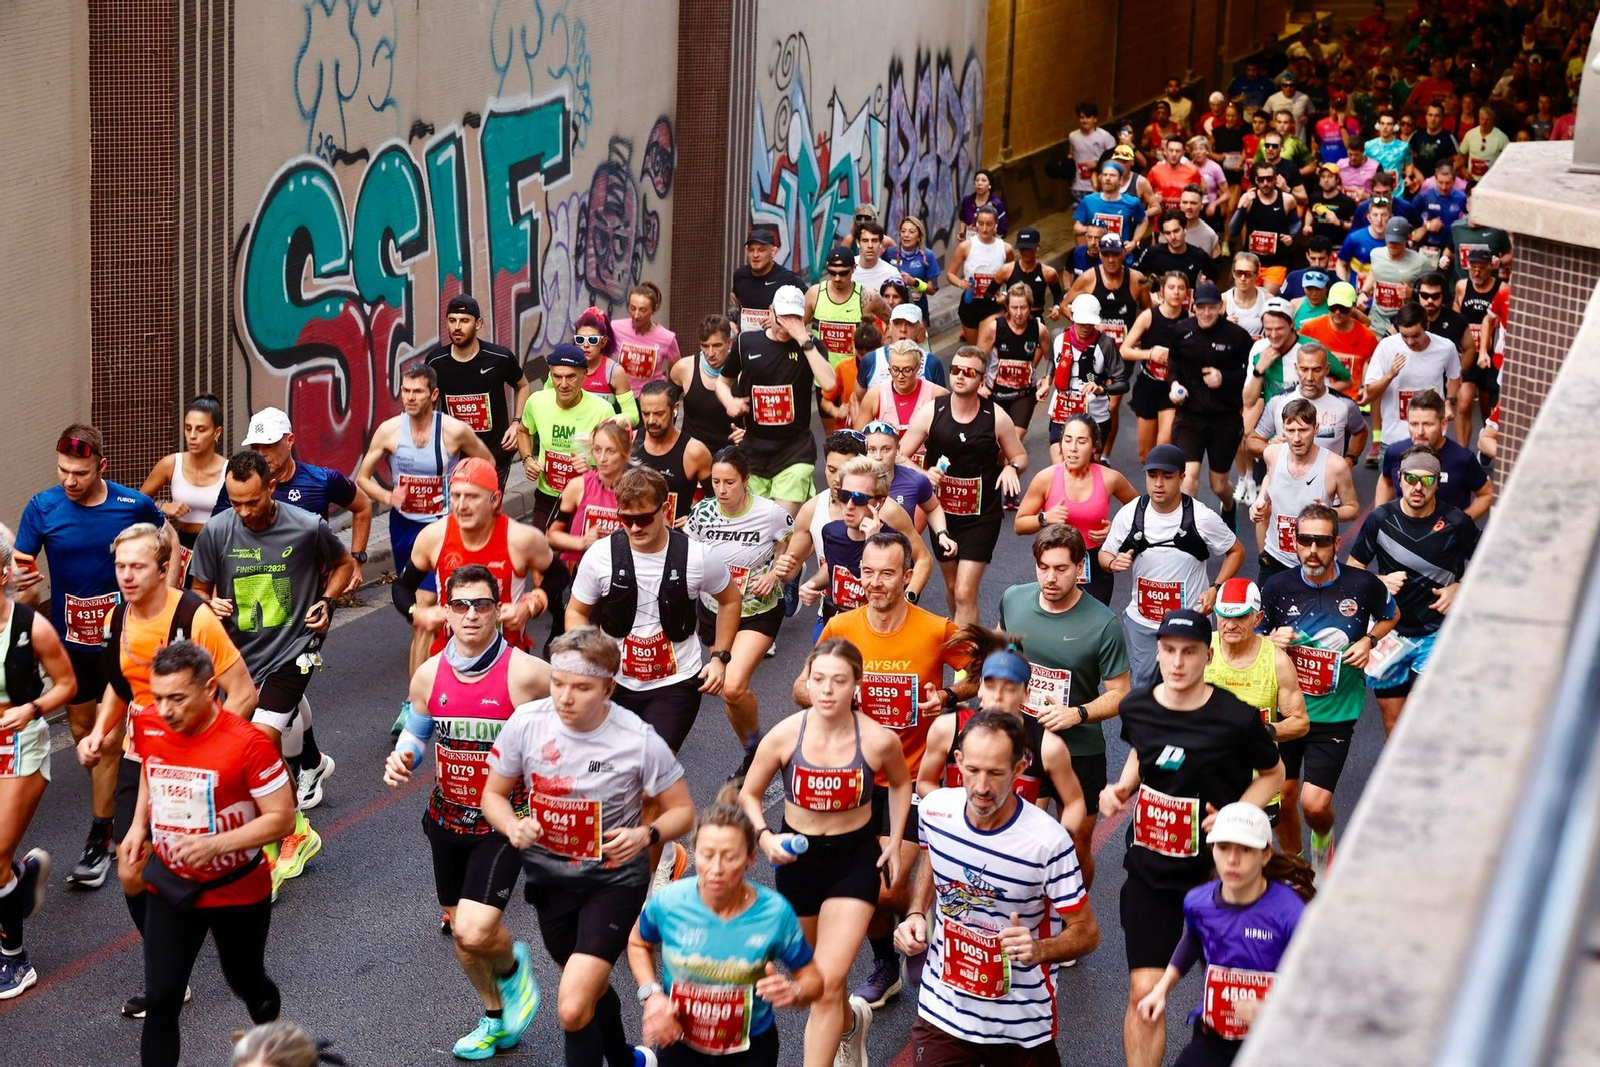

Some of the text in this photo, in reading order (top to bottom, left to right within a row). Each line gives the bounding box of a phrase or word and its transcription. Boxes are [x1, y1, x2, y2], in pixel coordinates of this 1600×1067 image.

[826, 330, 845, 338] 6210
[761, 396, 780, 404] 7349
[456, 403, 477, 412] 9569
[552, 424, 576, 439] BAM
[552, 461, 573, 473] 5693
[410, 485, 433, 494] 5250
[946, 486, 968, 496] 9179
[843, 580, 865, 597] 5480
[1148, 581, 1178, 589] GENERALI
[1147, 590, 1171, 601] 4604
[76, 609, 105, 620] 4315
[632, 632, 664, 645] GENERALI
[632, 645, 657, 657] 5501
[863, 660, 911, 671] AYSKY
[1297, 657, 1321, 670] 5191
[869, 675, 908, 684] GENERALI
[867, 686, 898, 698] 3559
[445, 752, 485, 762] GENERALI
[446, 762, 475, 777] 7079
[807, 775, 842, 790] 5600
[543, 810, 577, 827] 6041
[1147, 804, 1176, 824] 8049
[957, 926, 997, 948] GENERALI
[953, 938, 989, 963] 10051
